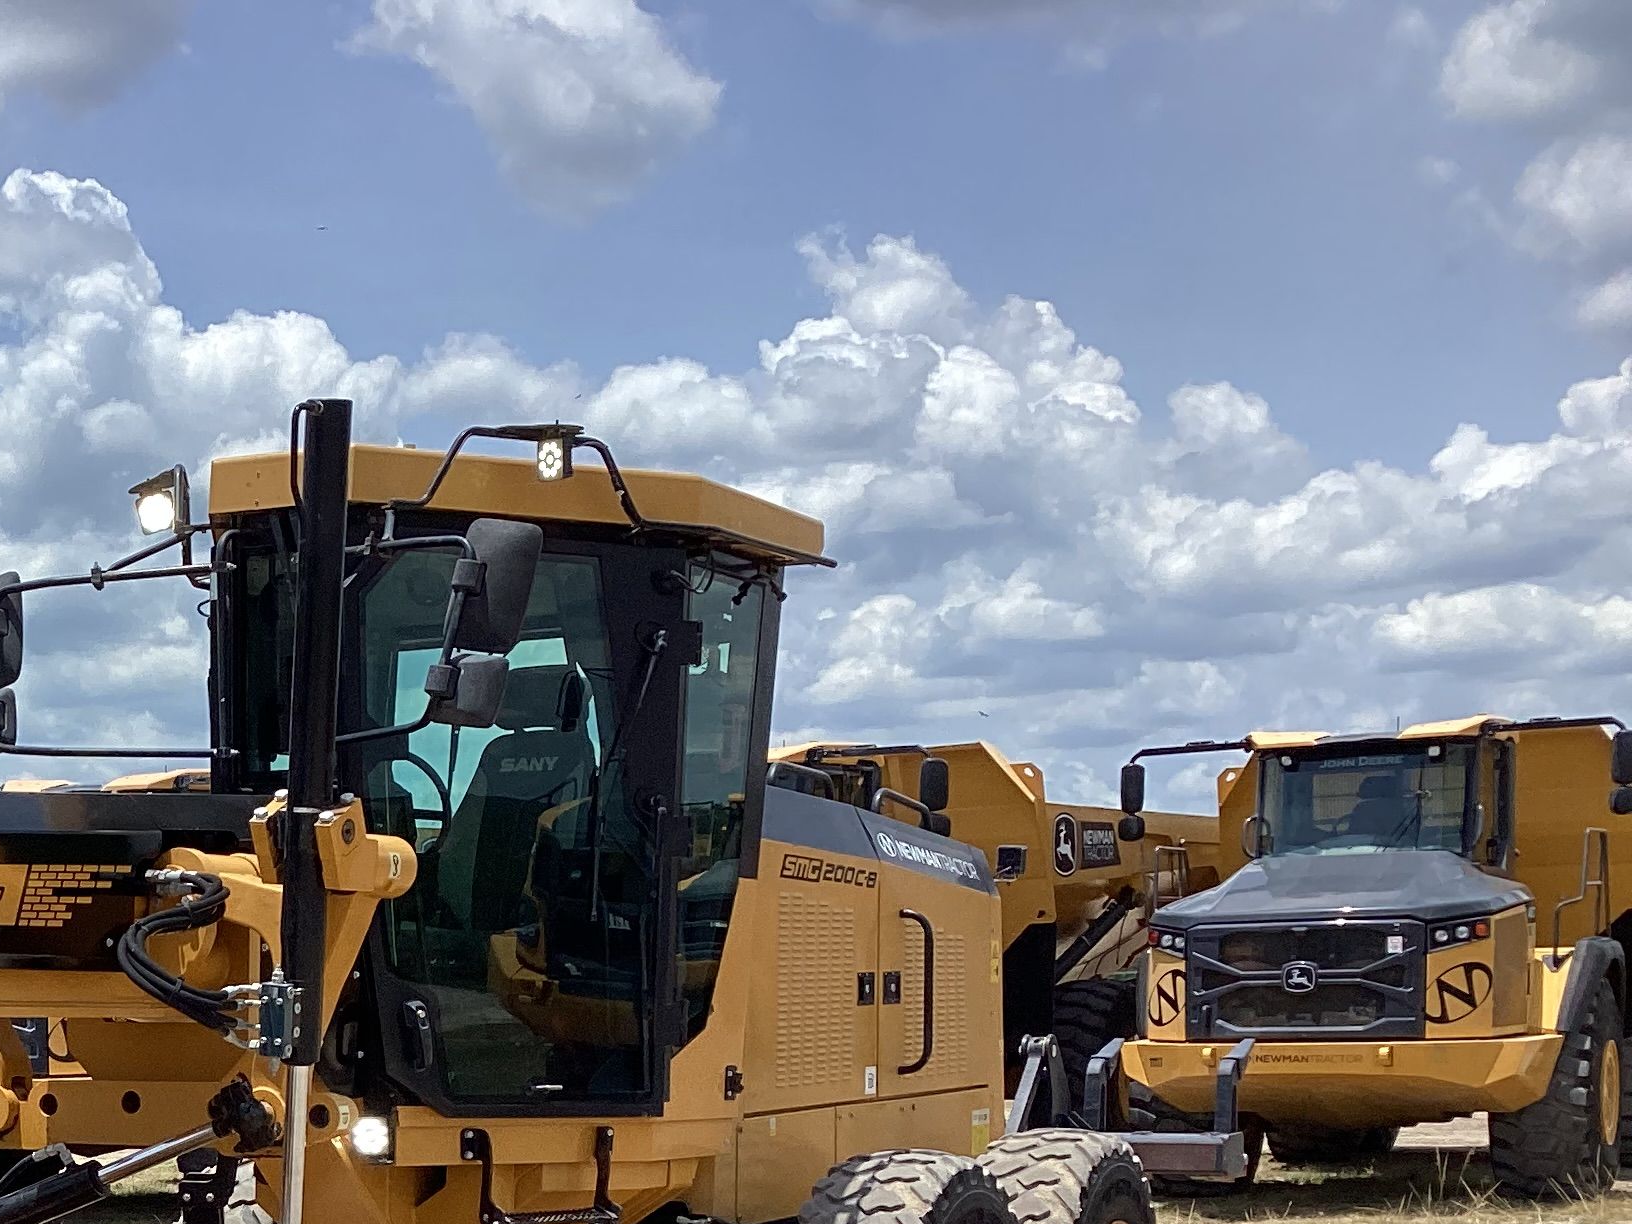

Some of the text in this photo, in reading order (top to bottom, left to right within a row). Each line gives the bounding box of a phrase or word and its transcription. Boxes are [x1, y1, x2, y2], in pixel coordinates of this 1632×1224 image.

[500, 756, 560, 773] SANY
[1320, 754, 1405, 769] JOHN DEERE
[781, 855, 822, 882] SMG
